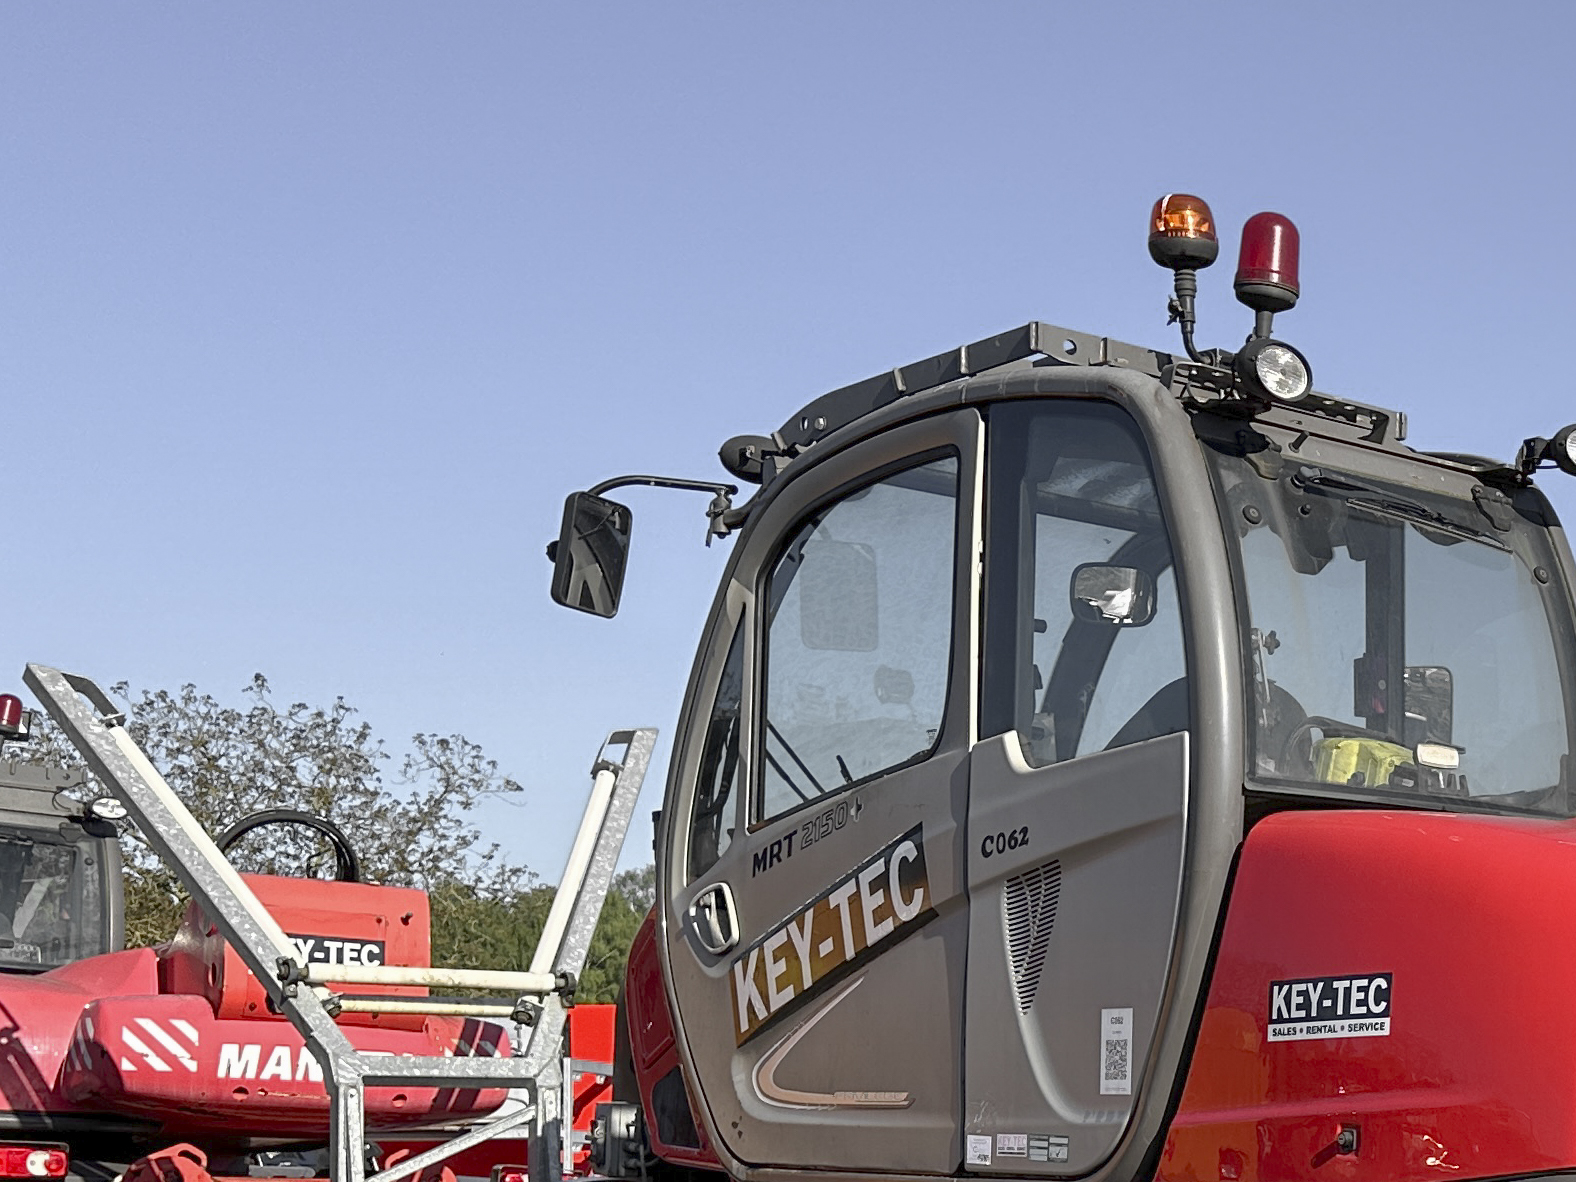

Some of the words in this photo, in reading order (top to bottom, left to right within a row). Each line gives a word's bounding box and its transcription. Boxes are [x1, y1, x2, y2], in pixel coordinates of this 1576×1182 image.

[752, 829, 798, 878] MRT
[980, 825, 1030, 858] C062
[289, 939, 381, 967] Y-TEC
[733, 839, 925, 1034] KEY-TEC
[1272, 977, 1388, 1020] KEY-TEC
[1272, 1027, 1297, 1037] SALES
[1305, 1024, 1338, 1035] RENTAL
[1347, 1021, 1386, 1033] SERVICE
